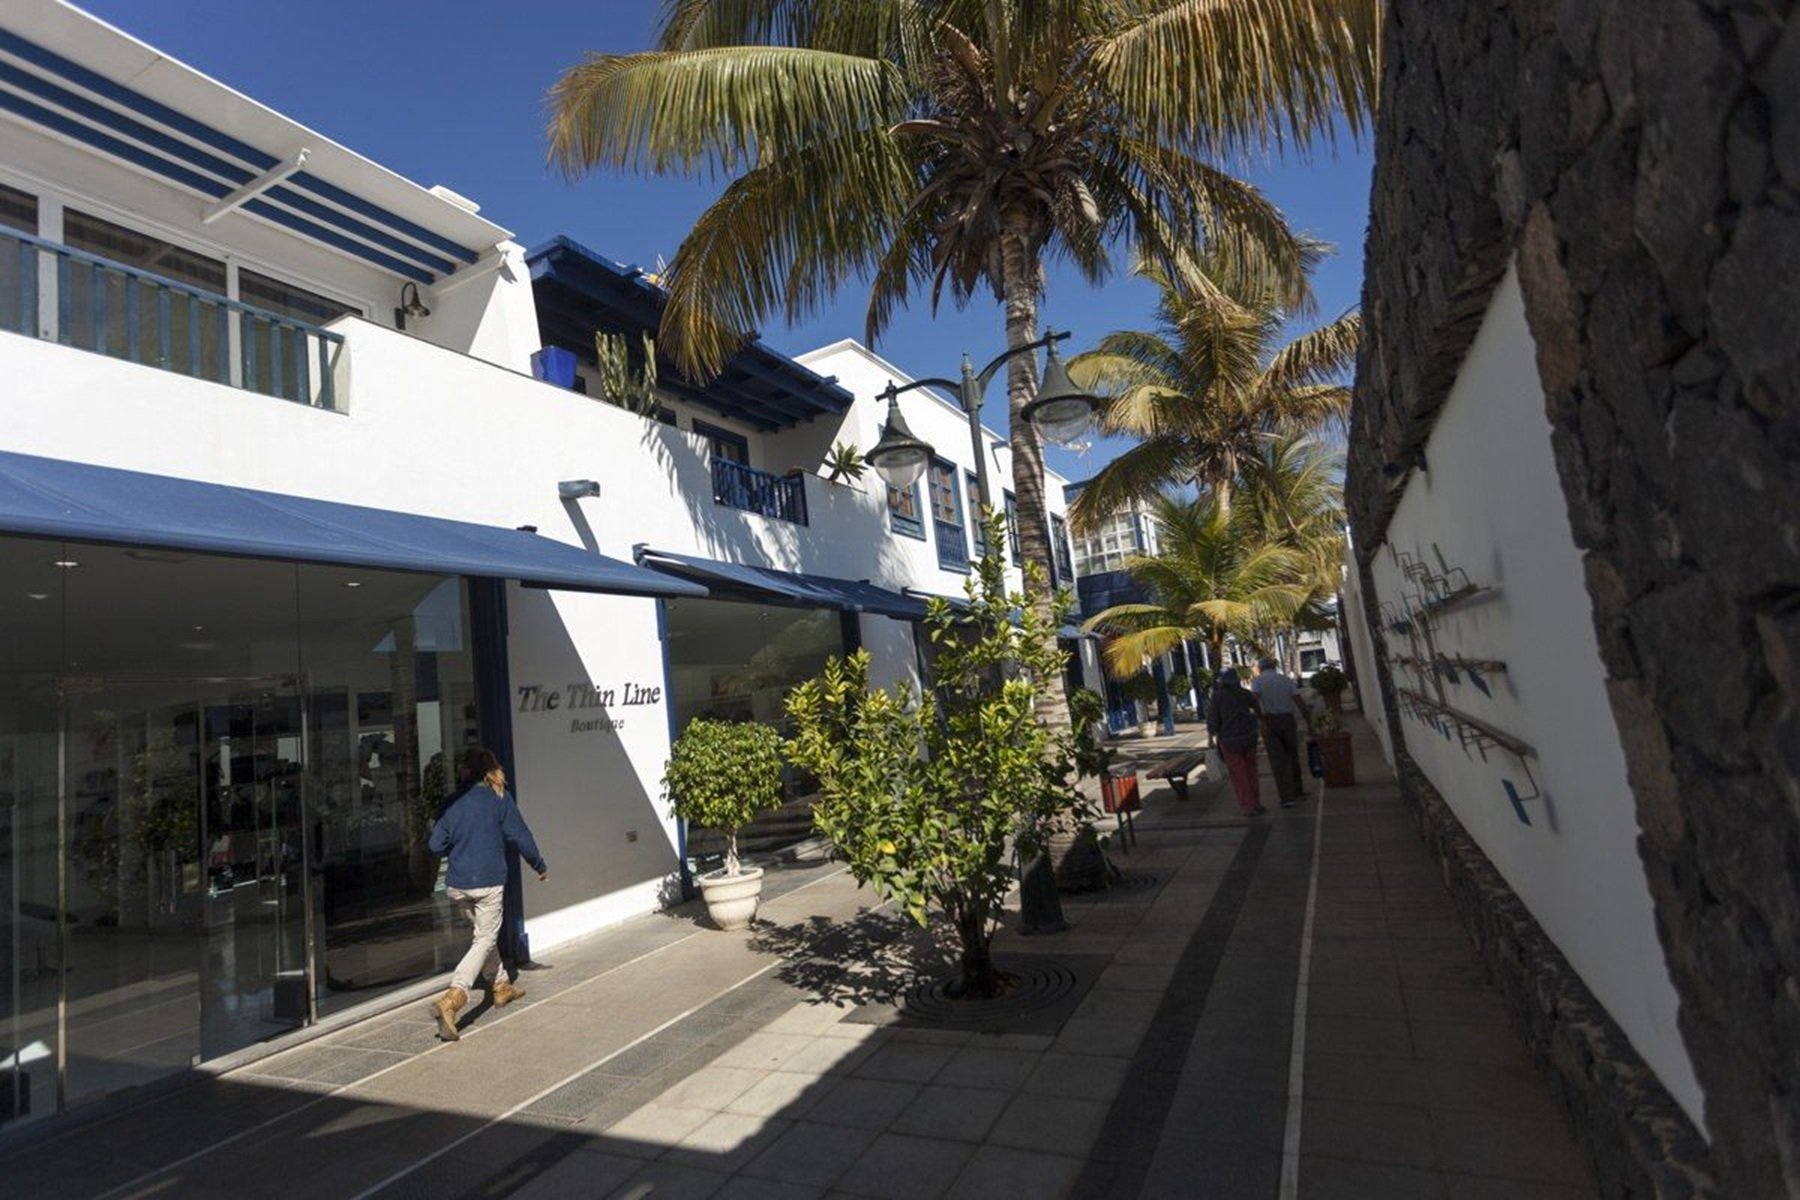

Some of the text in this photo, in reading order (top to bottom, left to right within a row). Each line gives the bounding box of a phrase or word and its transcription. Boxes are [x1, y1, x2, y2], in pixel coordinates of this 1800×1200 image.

[518, 682, 661, 712] The Thin Line
[570, 718, 625, 734] Boutique
